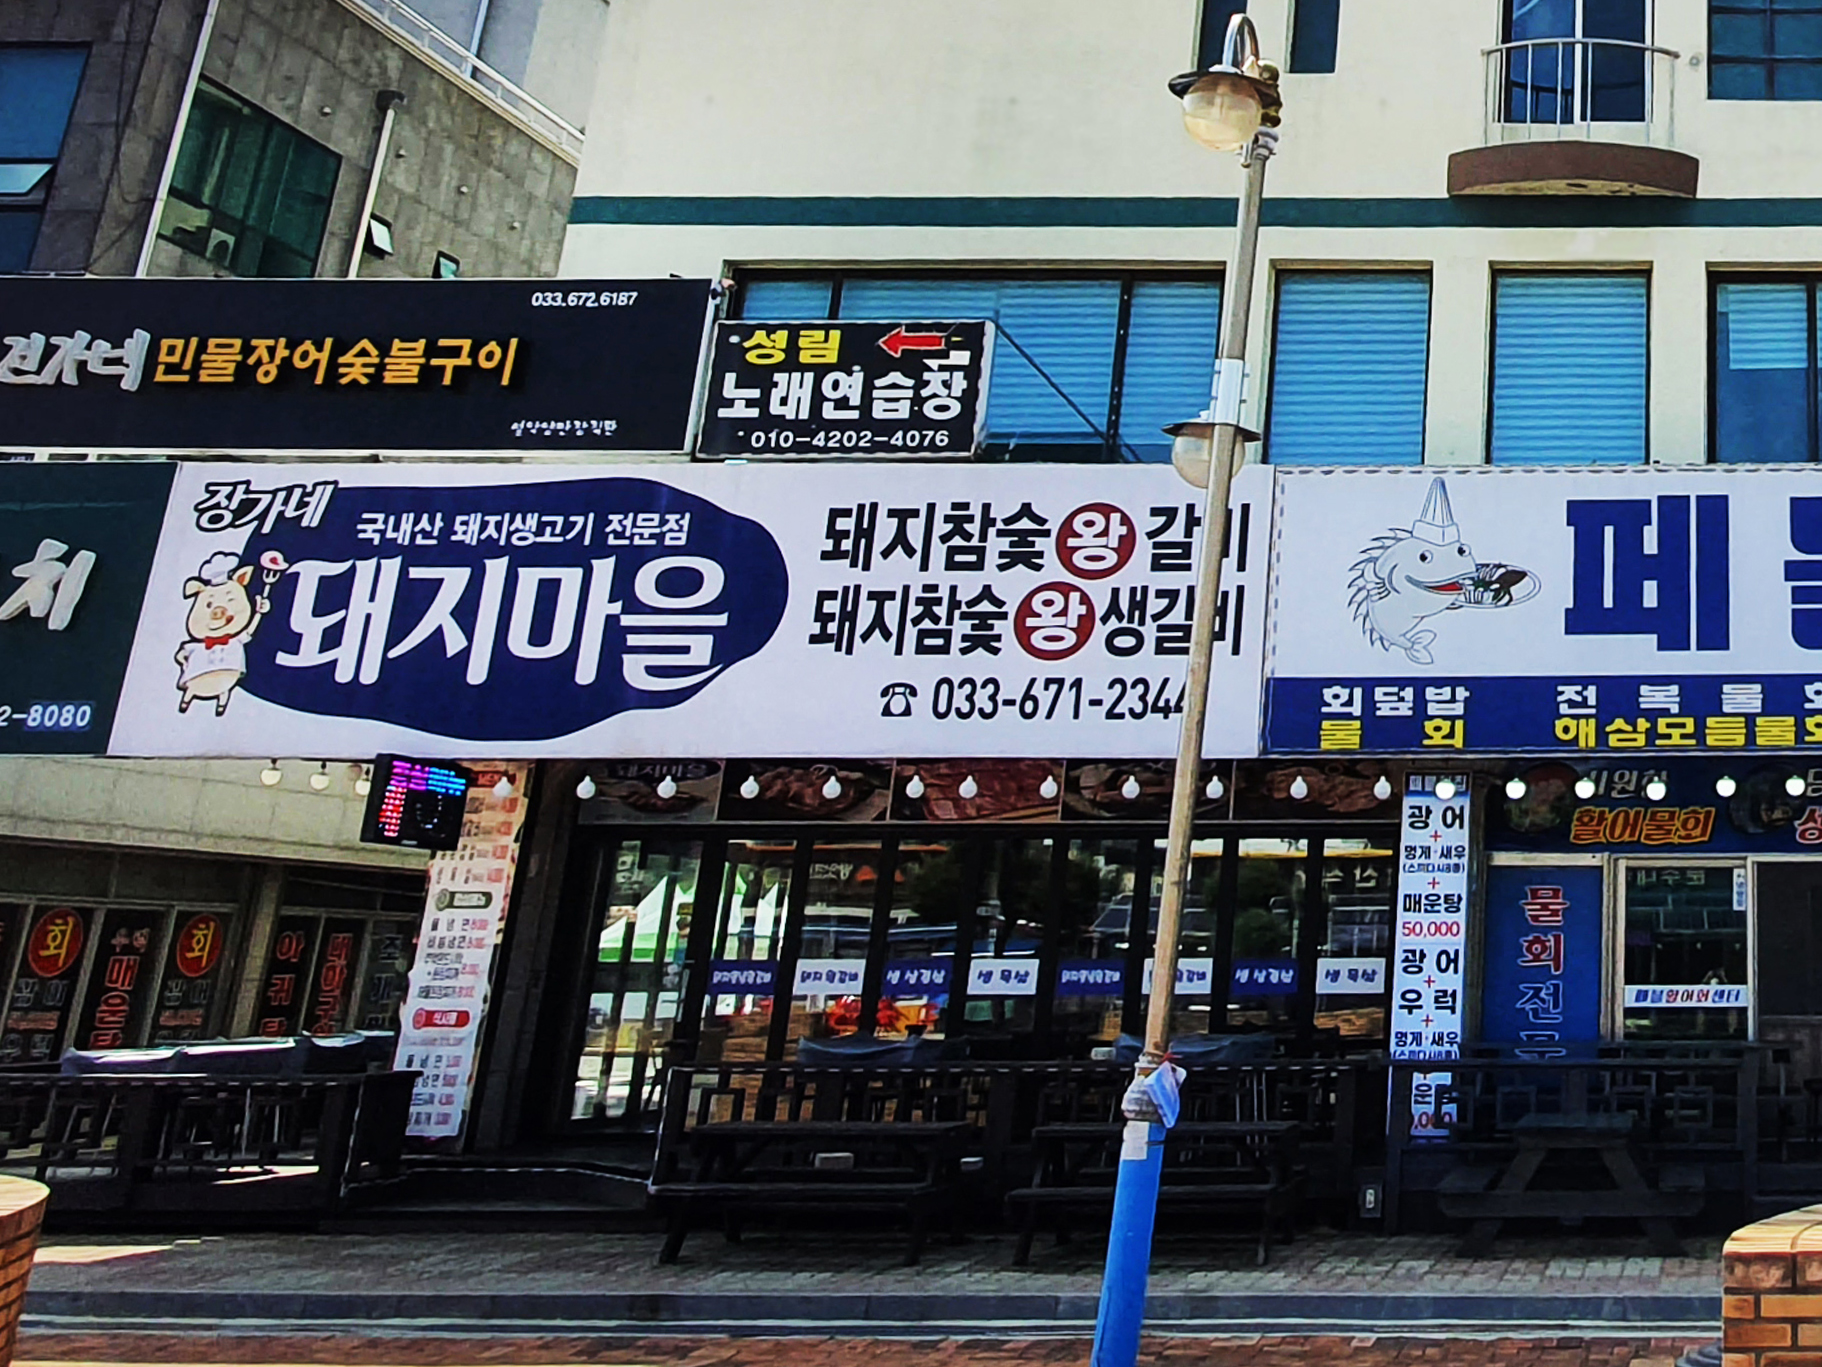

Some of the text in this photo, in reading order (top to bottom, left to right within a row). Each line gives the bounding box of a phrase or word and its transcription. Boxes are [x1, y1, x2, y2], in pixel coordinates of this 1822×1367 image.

[531, 291, 638, 308] 033.672.6187
[742, 329, 842, 365] 성림
[717, 370, 968, 421] 노래연습장
[750, 430, 950, 449] 010-4202-4076
[194, 480, 339, 533] 장가네
[355, 511, 691, 546] 국내산 돼지생고기 전문점
[275, 553, 730, 691] 돼지마을
[1321, 684, 1470, 715] 회덮밥
[1319, 718, 1465, 750] 물회
[1408, 805, 1465, 830] 광어
[1570, 806, 1716, 844] 활어물회
[1403, 893, 1463, 913] 매운탕
[38, 916, 76, 968] 회
[184, 921, 216, 968] 회
[1402, 921, 1461, 937] 50,000
[1401, 949, 1460, 975] 광어
[1399, 989, 1457, 1015] 우럭
